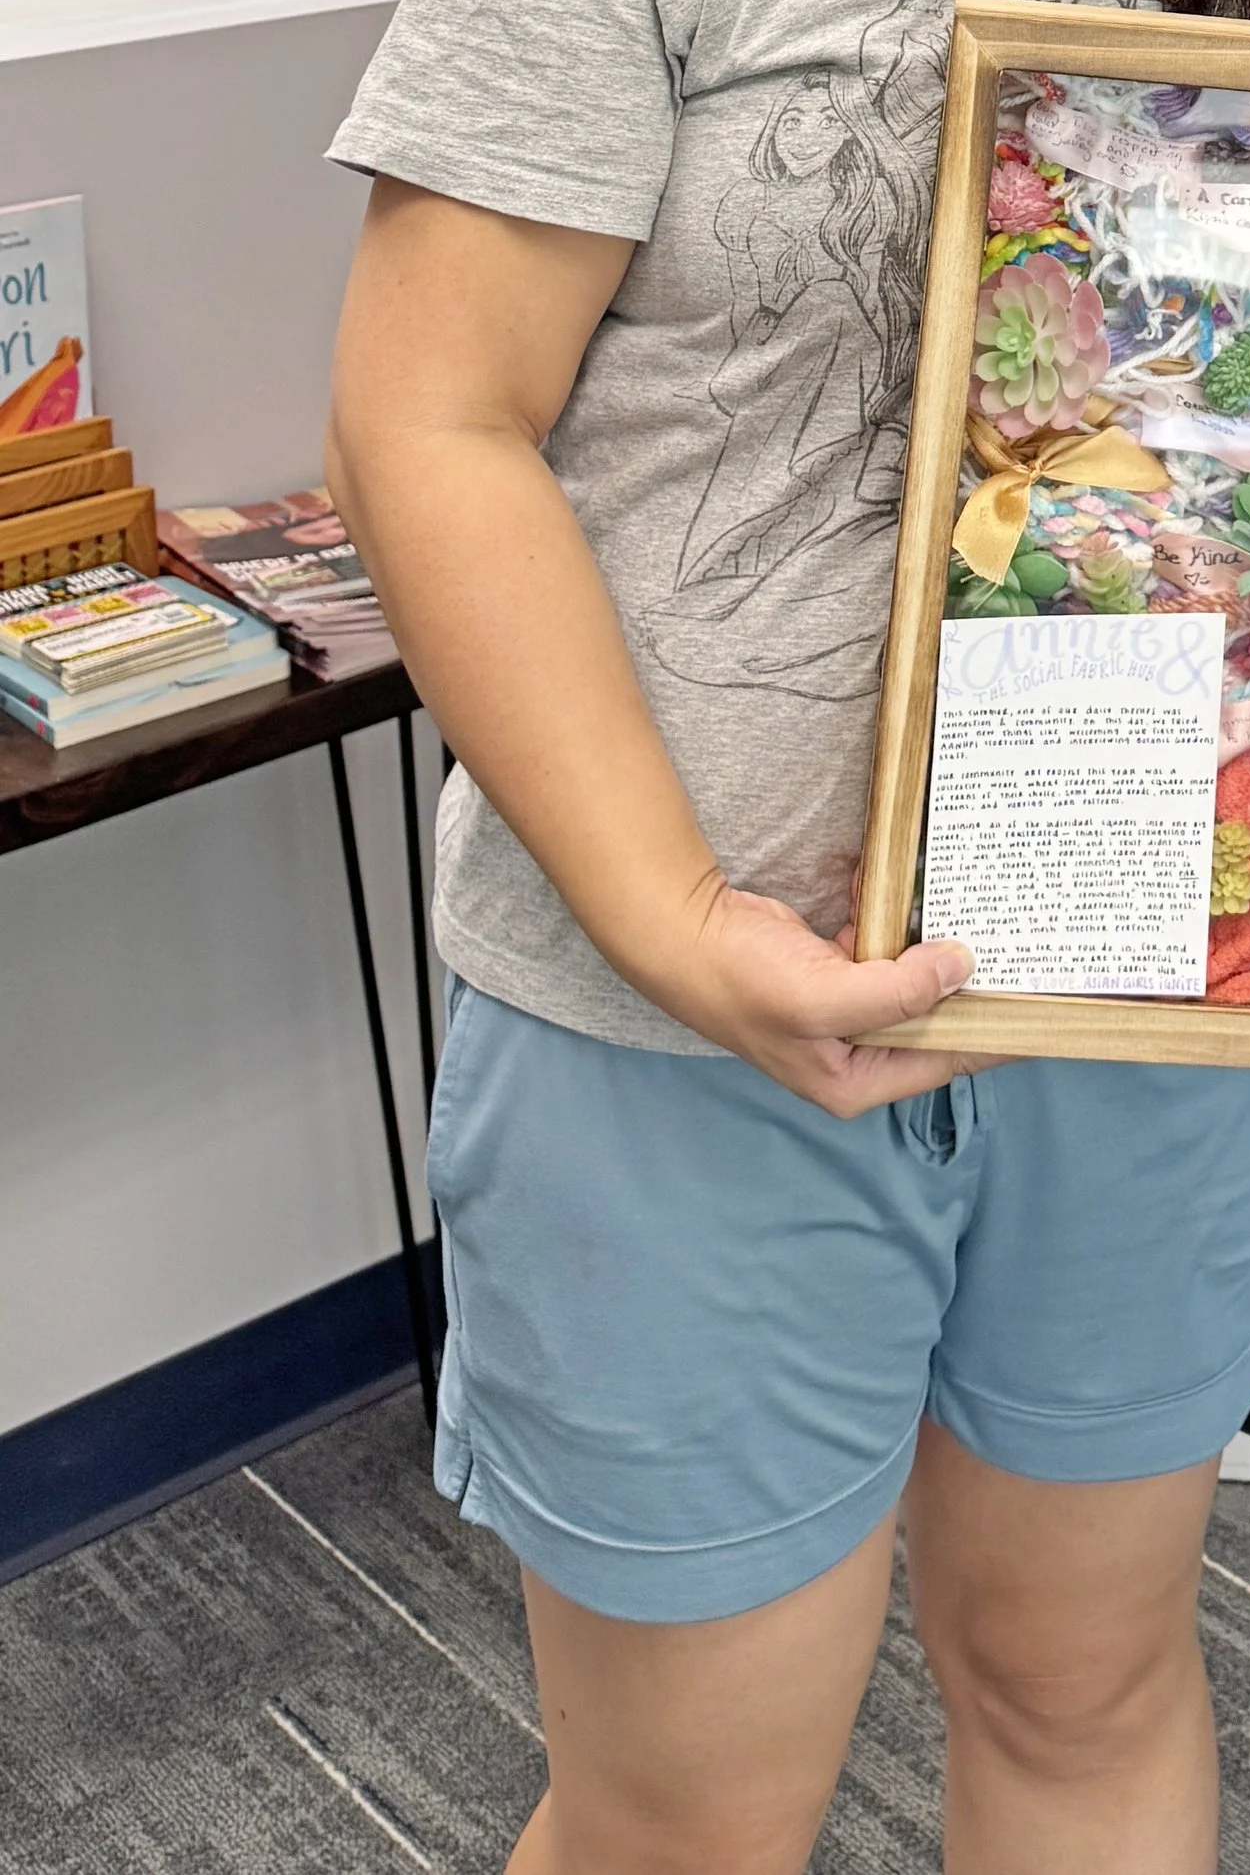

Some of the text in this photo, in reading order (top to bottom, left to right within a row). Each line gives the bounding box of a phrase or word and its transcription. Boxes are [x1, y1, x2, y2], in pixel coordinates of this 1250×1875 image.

[0, 261, 48, 305] on
[0, 320, 36, 375] ri
[1153, 544, 1181, 564] Be
